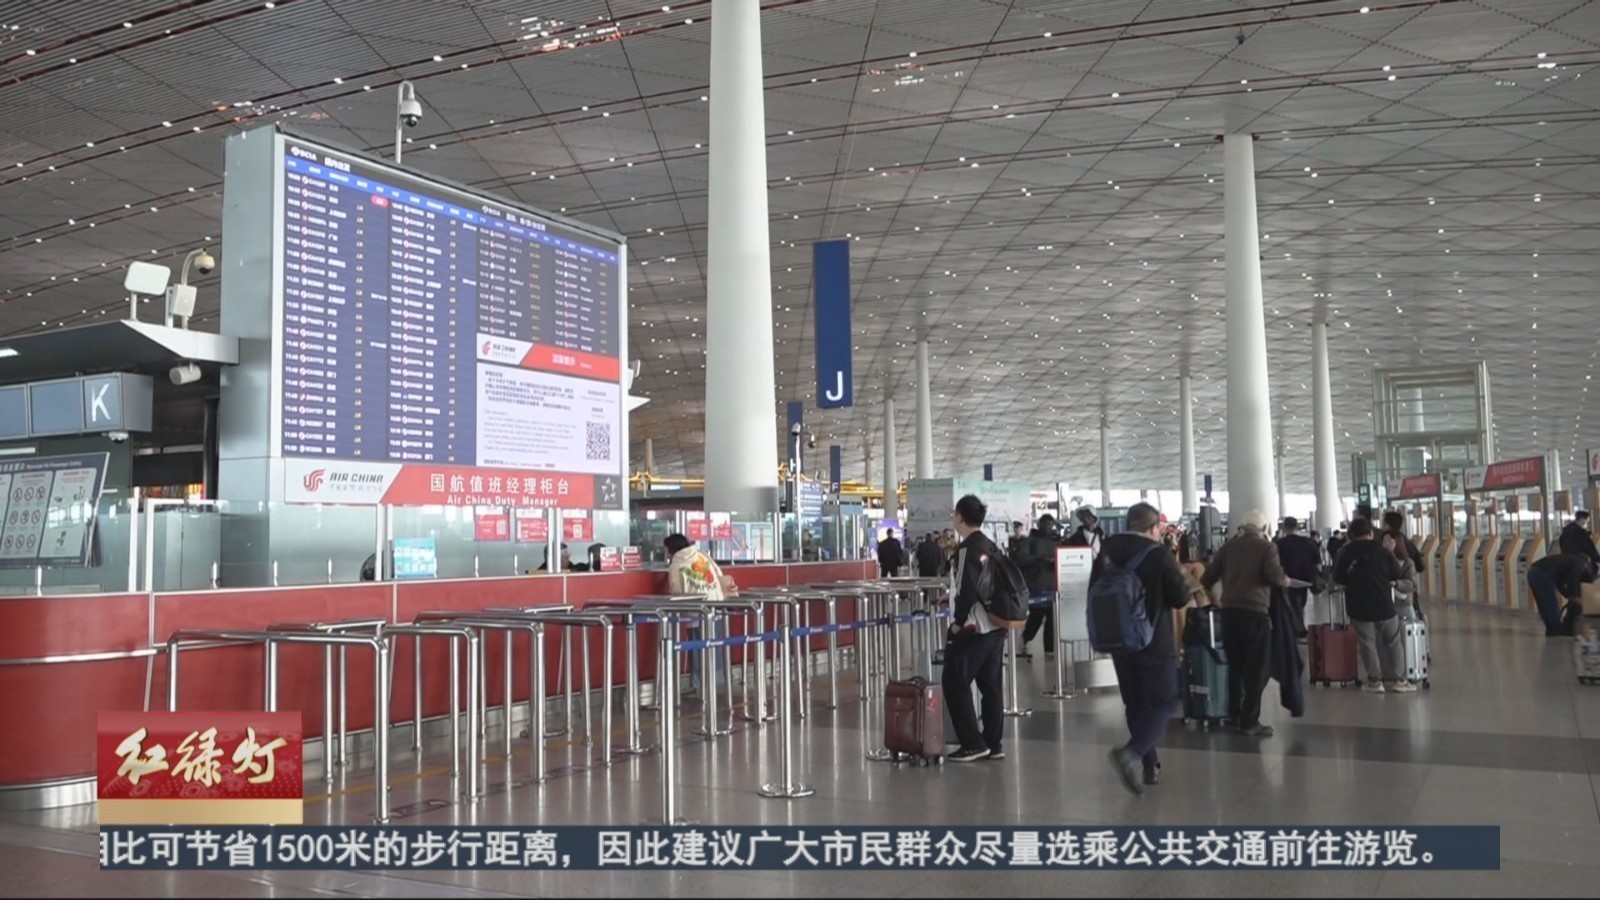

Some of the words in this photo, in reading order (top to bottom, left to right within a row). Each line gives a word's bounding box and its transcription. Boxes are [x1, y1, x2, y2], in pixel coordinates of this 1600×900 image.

[825, 371, 844, 402] J
[91, 383, 111, 423] K
[329, 472, 349, 482] AIR
[351, 473, 384, 483] CHINA
[430, 473, 570, 496] 国航值班经理柜台
[447, 494, 462, 504] Air
[465, 495, 491, 505] China
[495, 496, 517, 507] Duty
[522, 496, 559, 508] Manager
